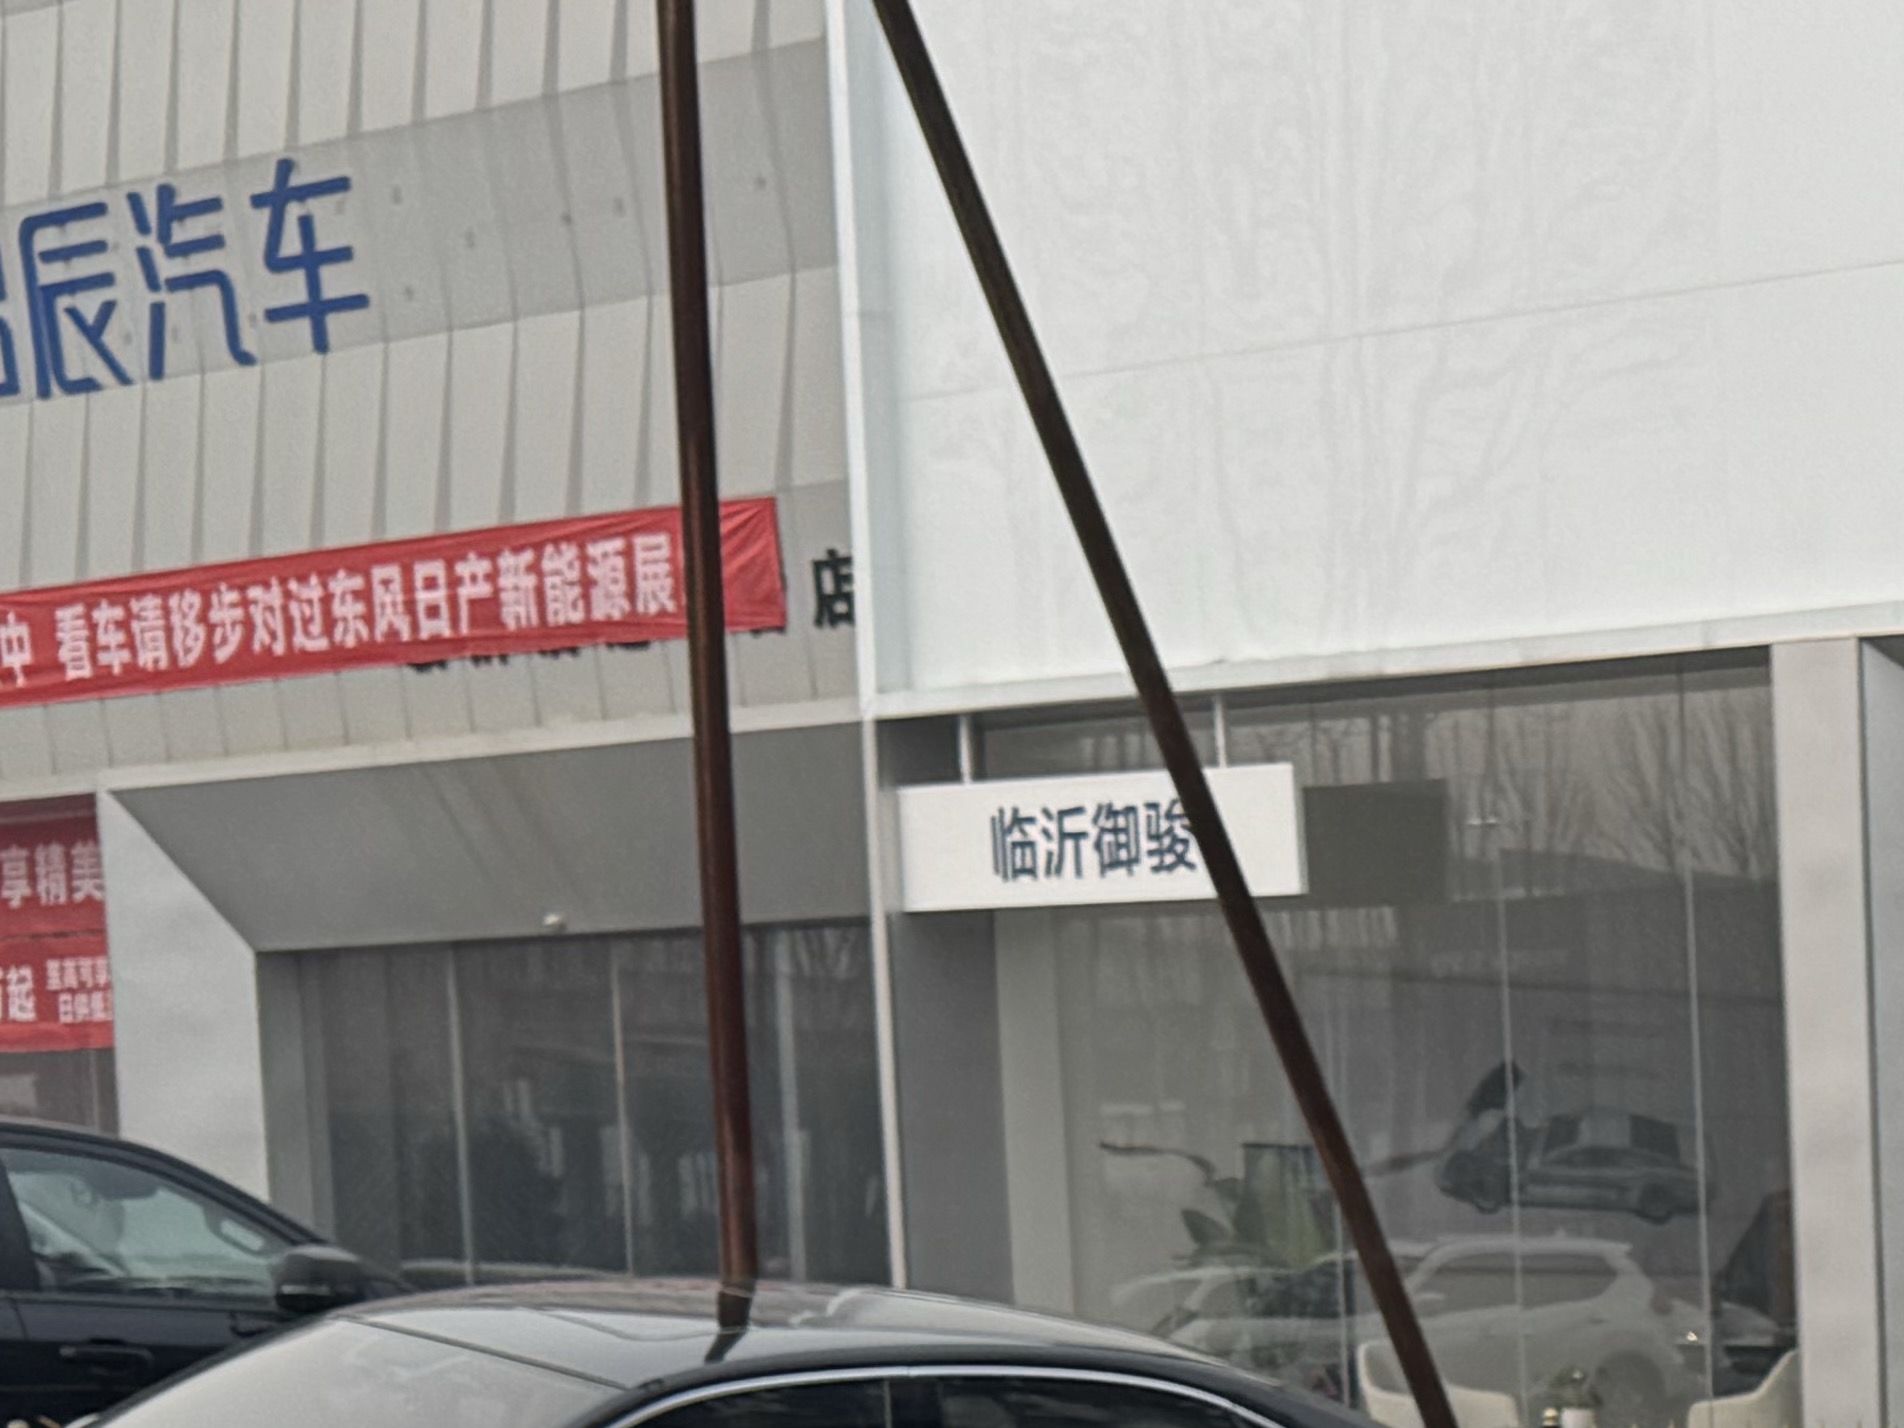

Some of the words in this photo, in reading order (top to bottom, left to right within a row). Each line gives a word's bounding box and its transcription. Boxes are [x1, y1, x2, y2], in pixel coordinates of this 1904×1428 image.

[0, 157, 370, 400] 辰汽车
[55, 531, 681, 682] 看车请移步对过东风日产新能源展
[990, 797, 1197, 883] 临沂御骏
